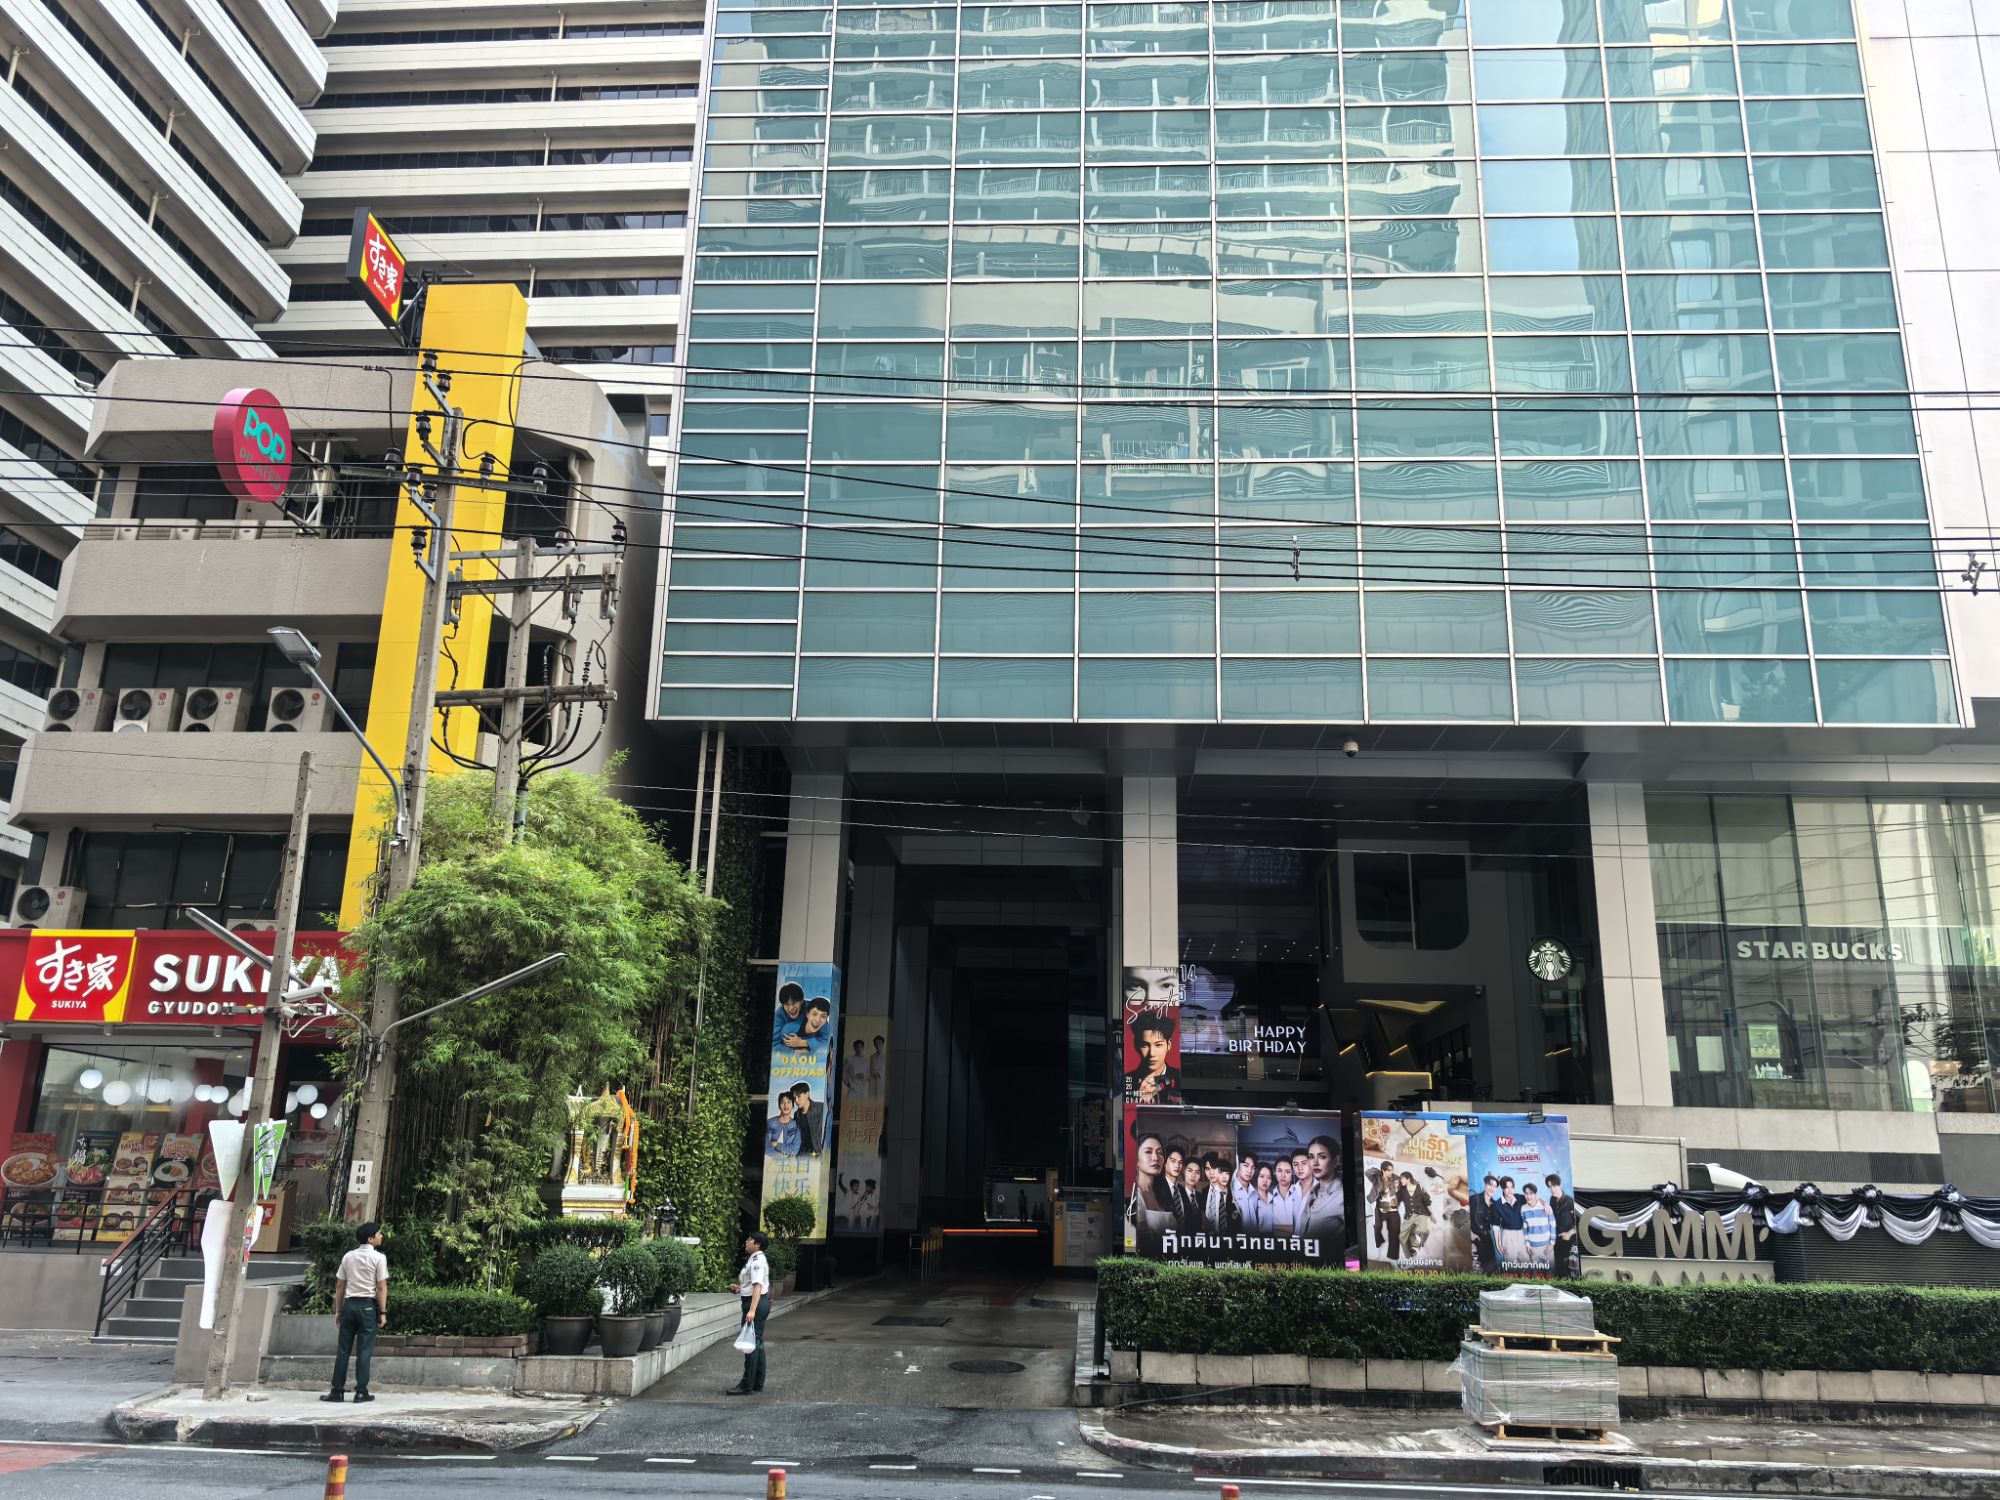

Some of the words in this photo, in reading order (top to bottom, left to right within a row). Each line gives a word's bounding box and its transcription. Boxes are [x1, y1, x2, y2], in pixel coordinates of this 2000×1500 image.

[368, 233, 398, 296] すき家
[1736, 941, 1904, 961] STARBUCKS
[35, 940, 118, 997] すき家
[51, 1000, 87, 1009] SUKIYA
[1254, 1025, 1307, 1039] HAPPY
[1228, 1040, 1307, 1054] BIRTHDAY
[1468, 1117, 1479, 1125] 25
[1426, 1133, 1449, 1153] รัก
[1498, 1136, 1511, 1145] MY
[1497, 1145, 1540, 1155] ROMANCE
[1499, 1154, 1539, 1162] SCAMMER
[355, 1175, 366, 1185] 86
